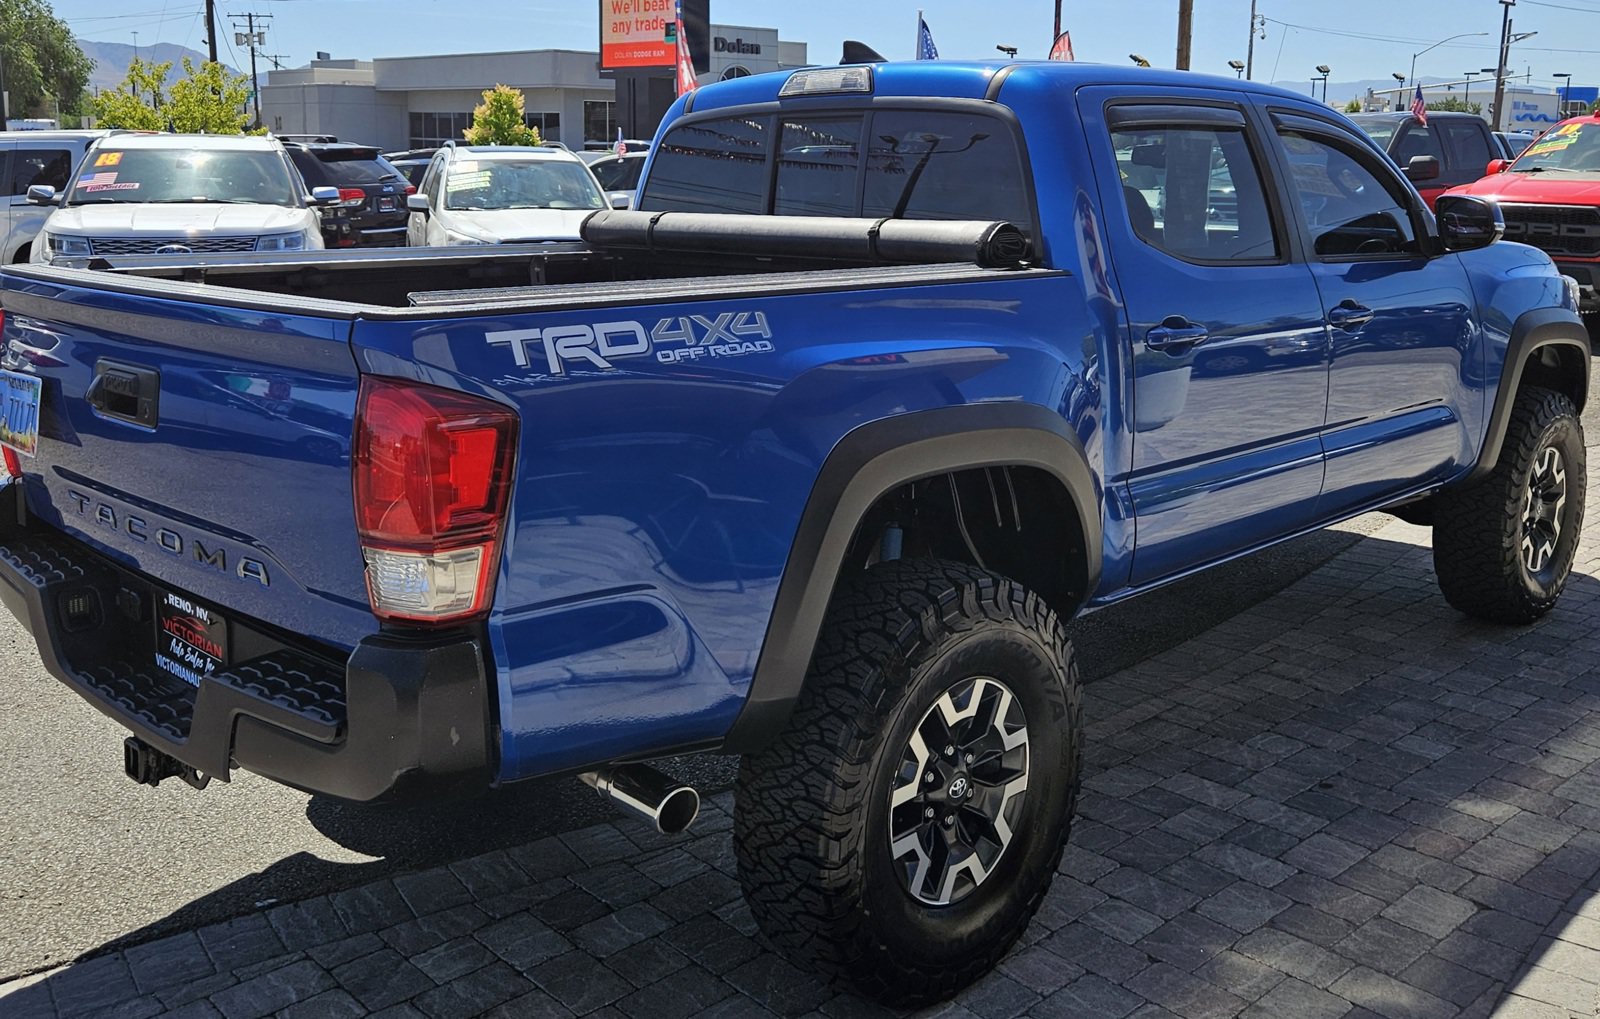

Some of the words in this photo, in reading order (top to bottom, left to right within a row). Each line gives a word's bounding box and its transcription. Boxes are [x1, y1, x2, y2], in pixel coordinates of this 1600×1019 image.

[611, 0, 640, 14] We'll
[643, 0, 670, 12] beat
[612, 20, 632, 35] any
[635, 16, 665, 31] trade
[633, 50, 652, 58] DODGE
[714, 37, 761, 55] Dolan
[95, 152, 122, 166] 18
[485, 320, 653, 376] TRD
[650, 311, 773, 346] 4X4
[656, 347, 706, 364] OFF
[710, 340, 775, 359] ROAD
[69, 489, 270, 587] TACOMA
[168, 593, 194, 615] RENO,
[196, 606, 210, 625] NV,
[162, 617, 223, 659] VICTORIAN
[170, 638, 184, 657] Auto
[185, 647, 204, 669] Sales
[155, 652, 202, 688] VICTORIANAU
